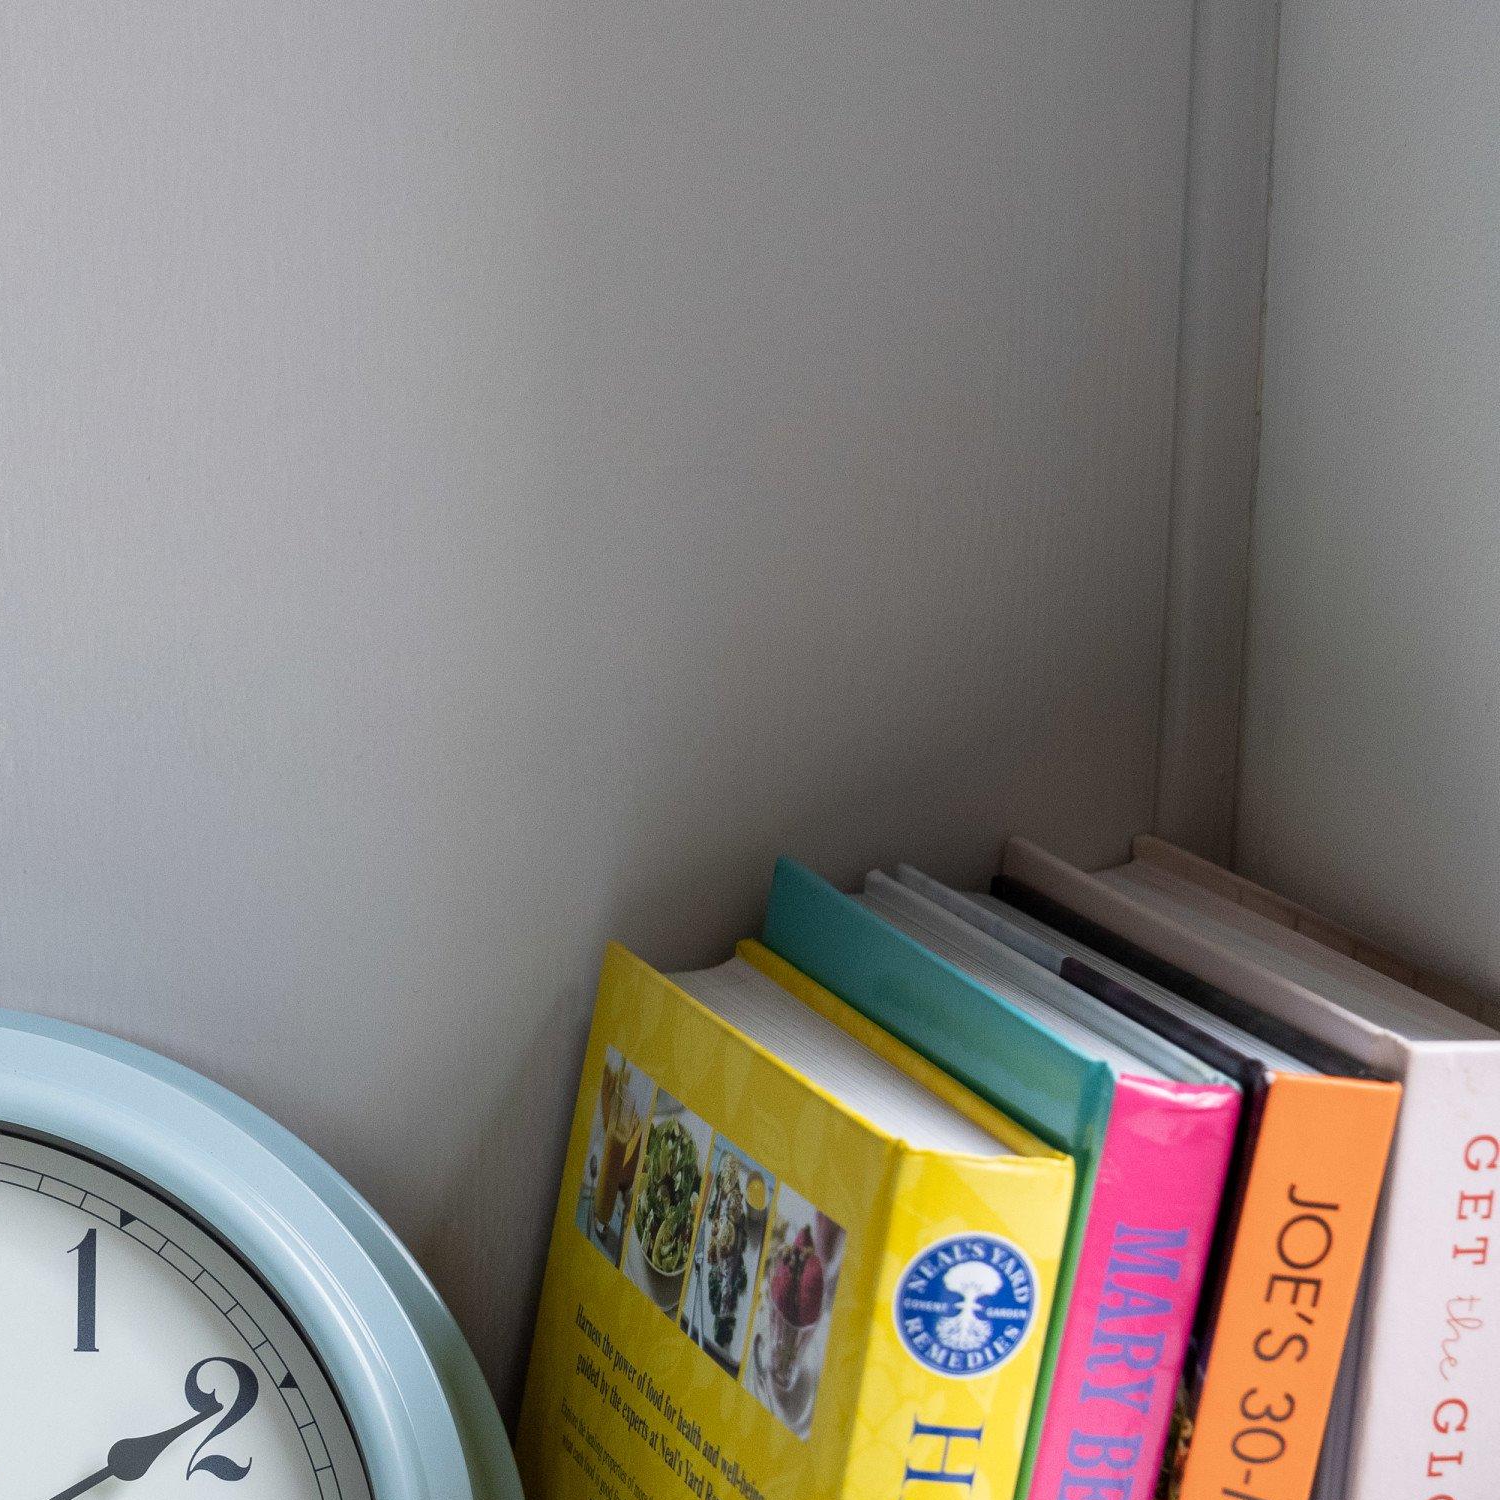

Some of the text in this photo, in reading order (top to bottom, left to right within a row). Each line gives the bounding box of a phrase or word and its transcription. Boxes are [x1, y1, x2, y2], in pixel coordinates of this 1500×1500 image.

[1452, 1133, 1499, 1266] GET
[66, 1228, 100, 1353] 1
[991, 1247, 1031, 1304] YARD
[1079, 1223, 1189, 1414] MARY
[1253, 1184, 1340, 1365] JOE'S
[1439, 1294, 1483, 1382] the
[574, 1303, 603, 1350] Harness
[601, 1330, 615, 1362] the
[612, 1347, 637, 1391] power
[635, 1364, 647, 1395] of
[644, 1373, 665, 1413] food
[662, 1391, 678, 1426] for
[675, 1404, 703, 1452] health
[701, 1429, 721, 1469] and
[904, 1317, 1021, 1370] REMEDIES
[184, 1356, 260, 1482] 2
[574, 1347, 600, 1396] guided
[598, 1372, 610, 1407] by
[608, 1381, 623, 1414] the
[619, 1394, 650, 1449] experts
[648, 1422, 659, 1453] at
[682, 1458, 704, 1499] Yard
